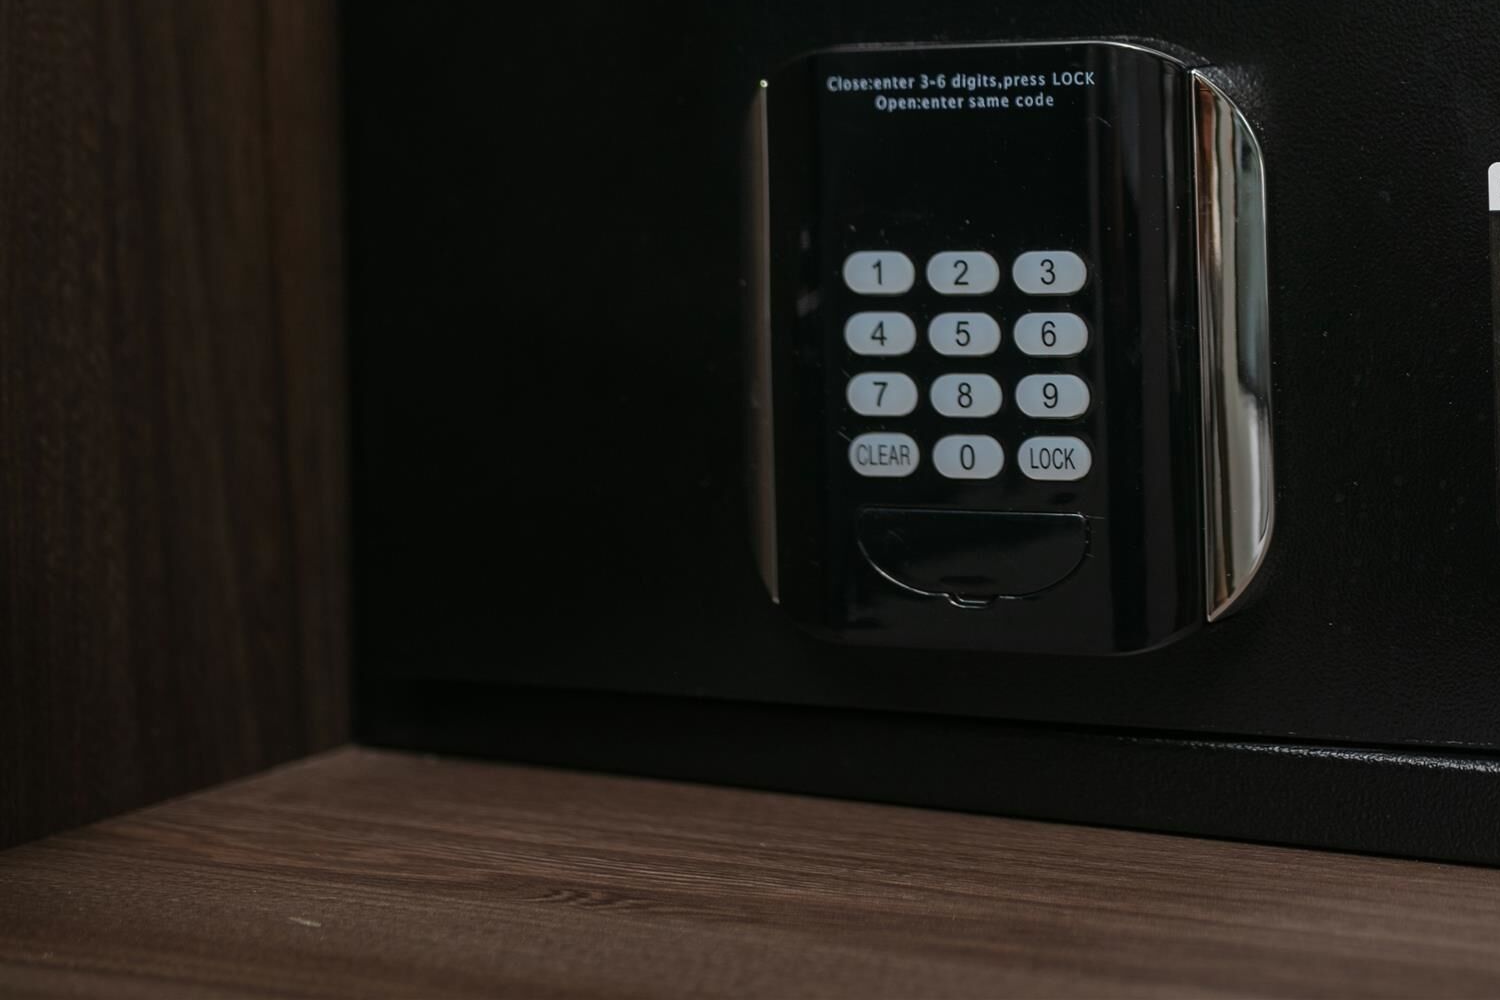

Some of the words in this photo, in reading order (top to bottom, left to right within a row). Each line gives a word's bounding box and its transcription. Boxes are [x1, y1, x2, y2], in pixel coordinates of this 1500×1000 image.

[827, 76, 915, 91] Close:enter
[921, 74, 946, 89] 3-6
[952, 73, 1046, 91] digits,press
[1052, 71, 1096, 86] LOCK
[875, 95, 964, 112] Open:enter
[969, 96, 1009, 108] same
[1015, 92, 1054, 107] code
[871, 258, 883, 286] 1
[952, 259, 970, 287] 2
[1039, 258, 1057, 286] 3
[869, 320, 888, 347] 4
[955, 320, 972, 348] 5
[1040, 320, 1057, 348] 6
[872, 380, 889, 408] 7
[956, 381, 974, 409] 8
[1042, 381, 1059, 410] 9
[856, 443, 911, 466] CLEAR
[959, 443, 976, 471] 0
[1030, 447, 1076, 470] LOCK
